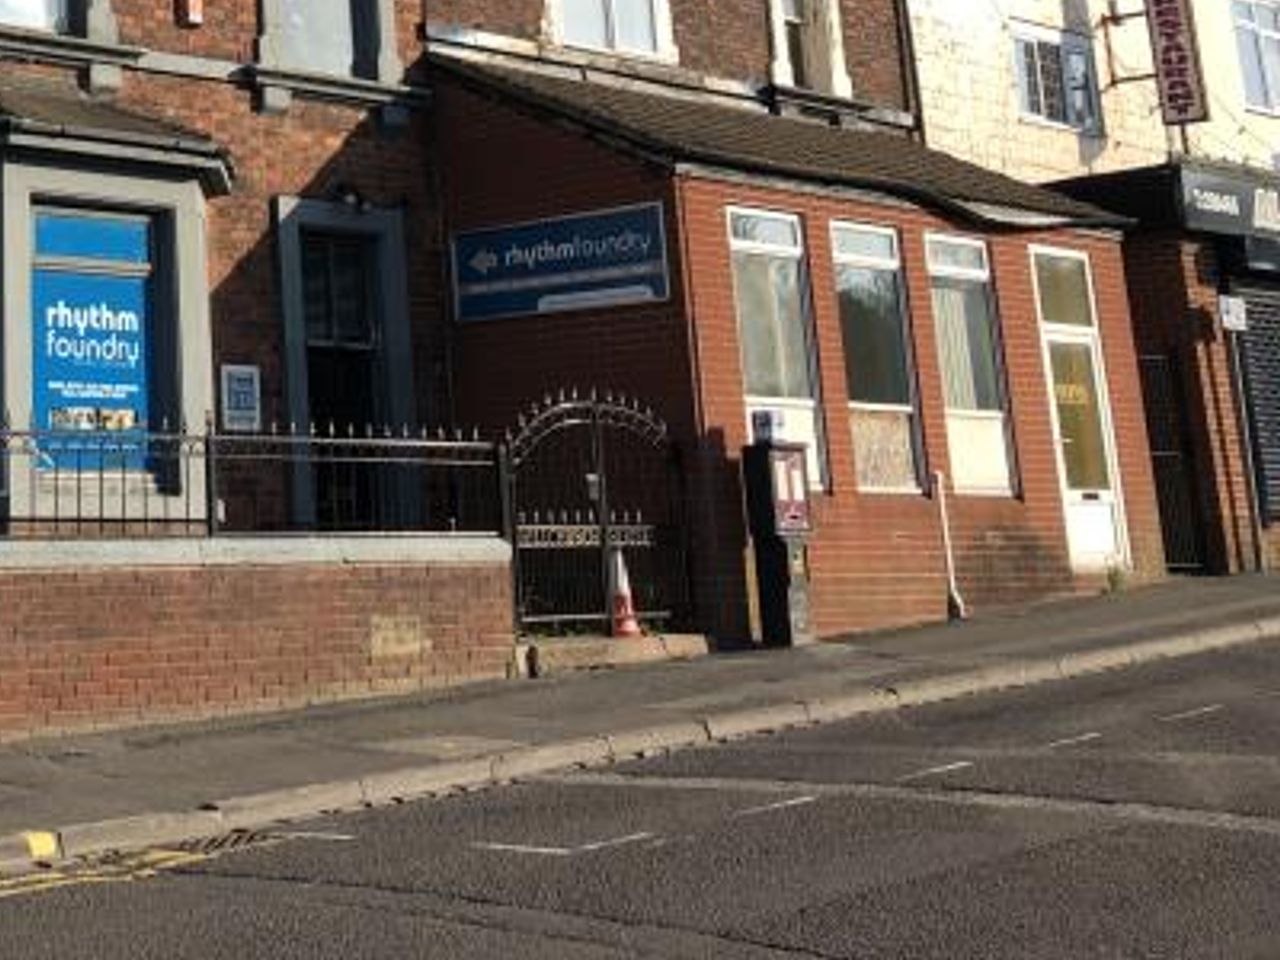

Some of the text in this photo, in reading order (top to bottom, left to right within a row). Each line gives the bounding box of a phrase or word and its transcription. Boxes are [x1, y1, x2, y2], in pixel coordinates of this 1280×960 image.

[504, 228, 652, 270] rhythmfoundry
[46, 300, 139, 337] rhythm
[46, 330, 140, 369] foundry
